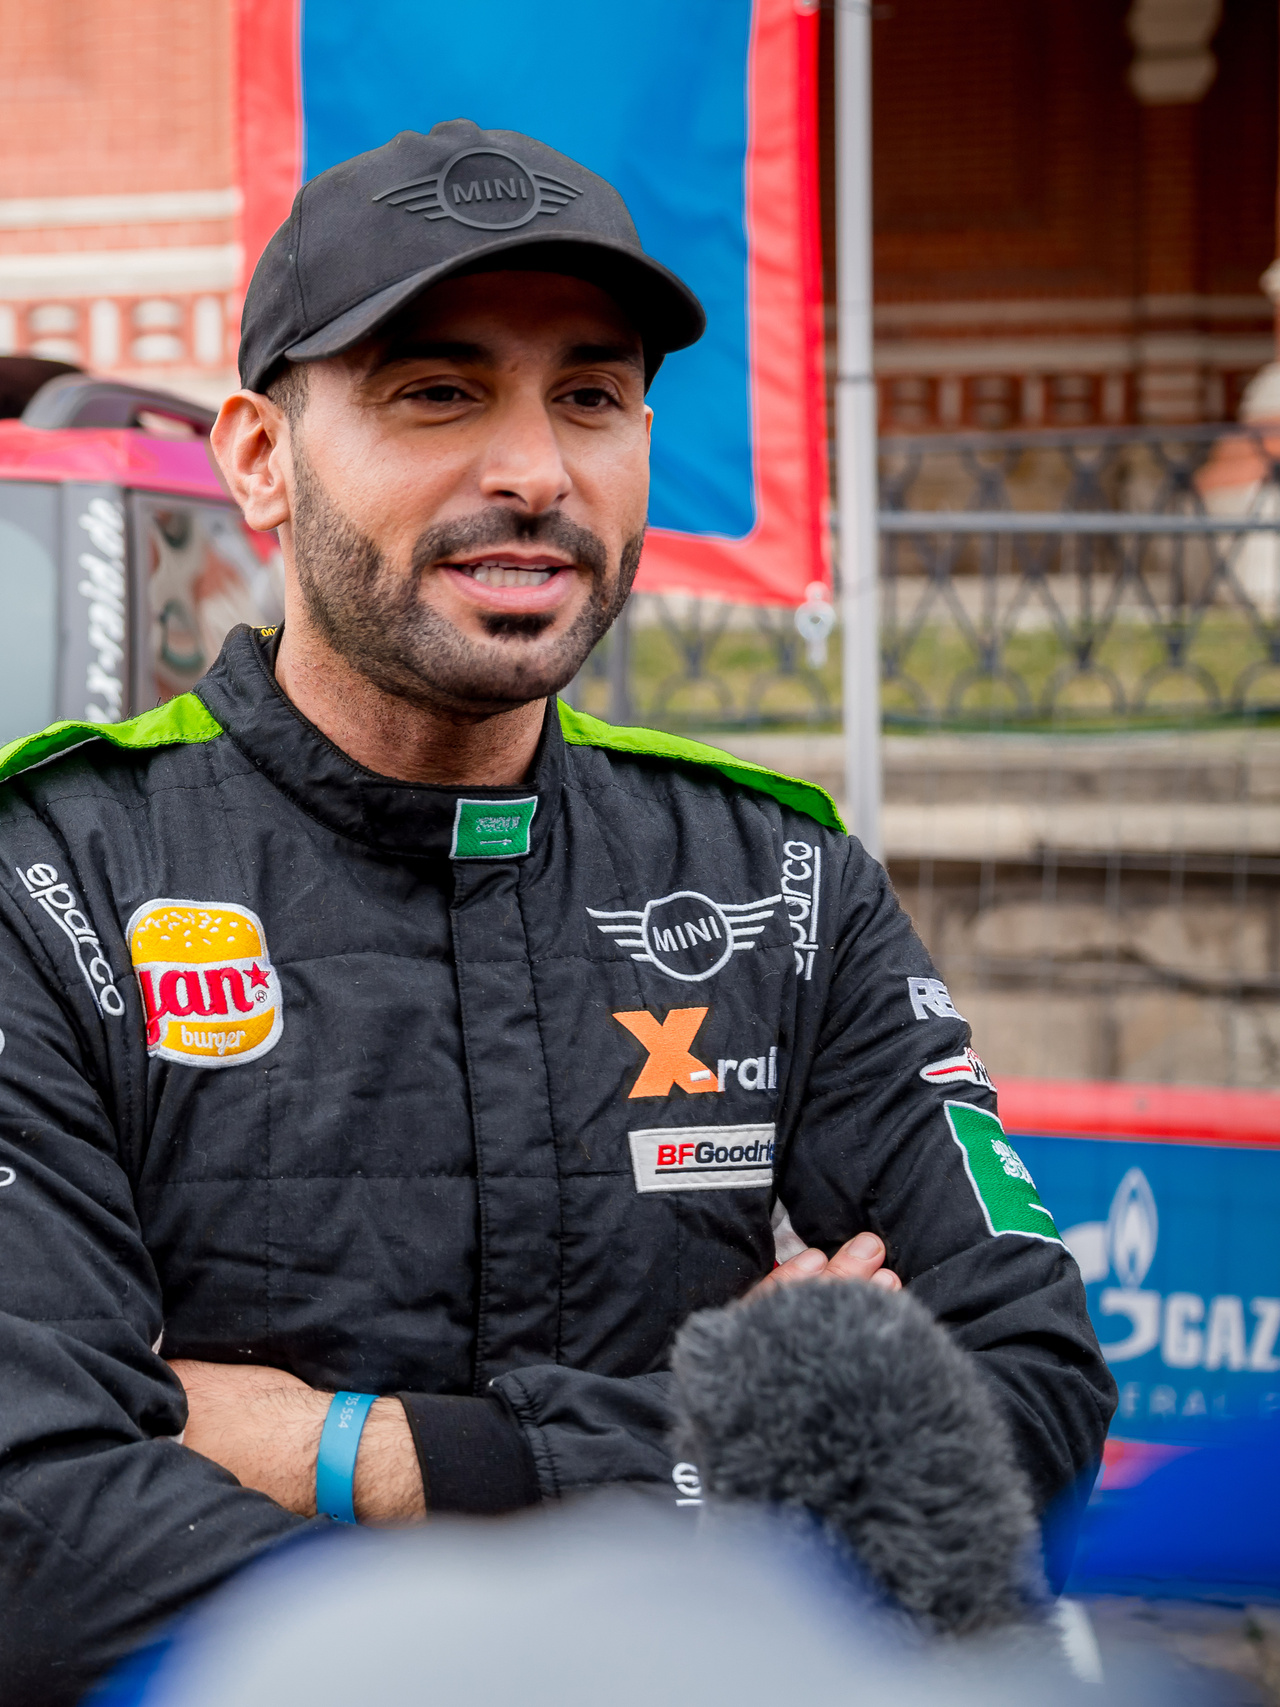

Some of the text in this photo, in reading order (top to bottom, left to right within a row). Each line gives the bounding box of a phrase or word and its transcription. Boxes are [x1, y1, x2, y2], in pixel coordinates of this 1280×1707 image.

[452, 177, 528, 206] MINI
[16, 862, 125, 1019] sparco
[652, 914, 723, 953] MINI
[180, 1024, 246, 1056] burger
[612, 1006, 778, 1099] X-rai
[656, 1139, 774, 1166] BFGoodri
